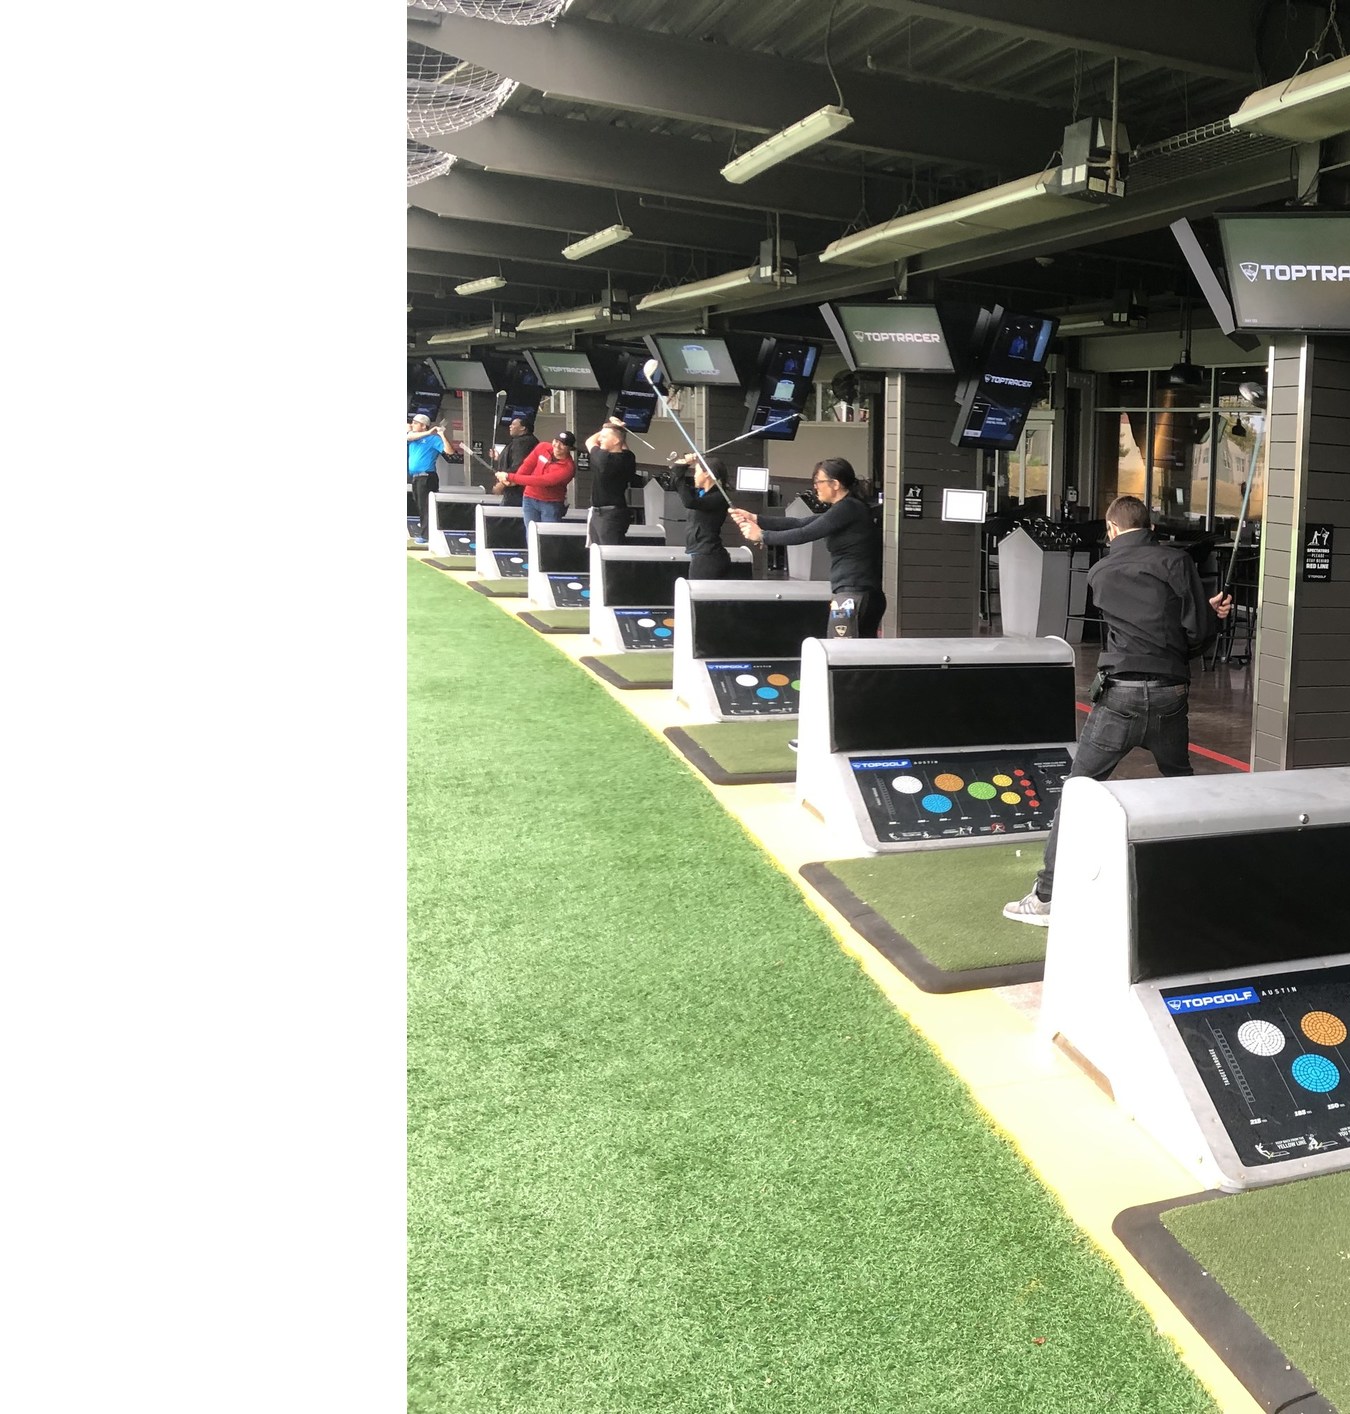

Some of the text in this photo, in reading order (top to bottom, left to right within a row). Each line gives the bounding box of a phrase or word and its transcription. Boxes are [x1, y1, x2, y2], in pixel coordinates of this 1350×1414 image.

[863, 332, 940, 343] TOPTRACER
[991, 375, 1032, 387] TOPTRACER
[861, 760, 909, 769] TOPGOLF
[1182, 986, 1298, 1008] TOPGOLF AUSTIN
